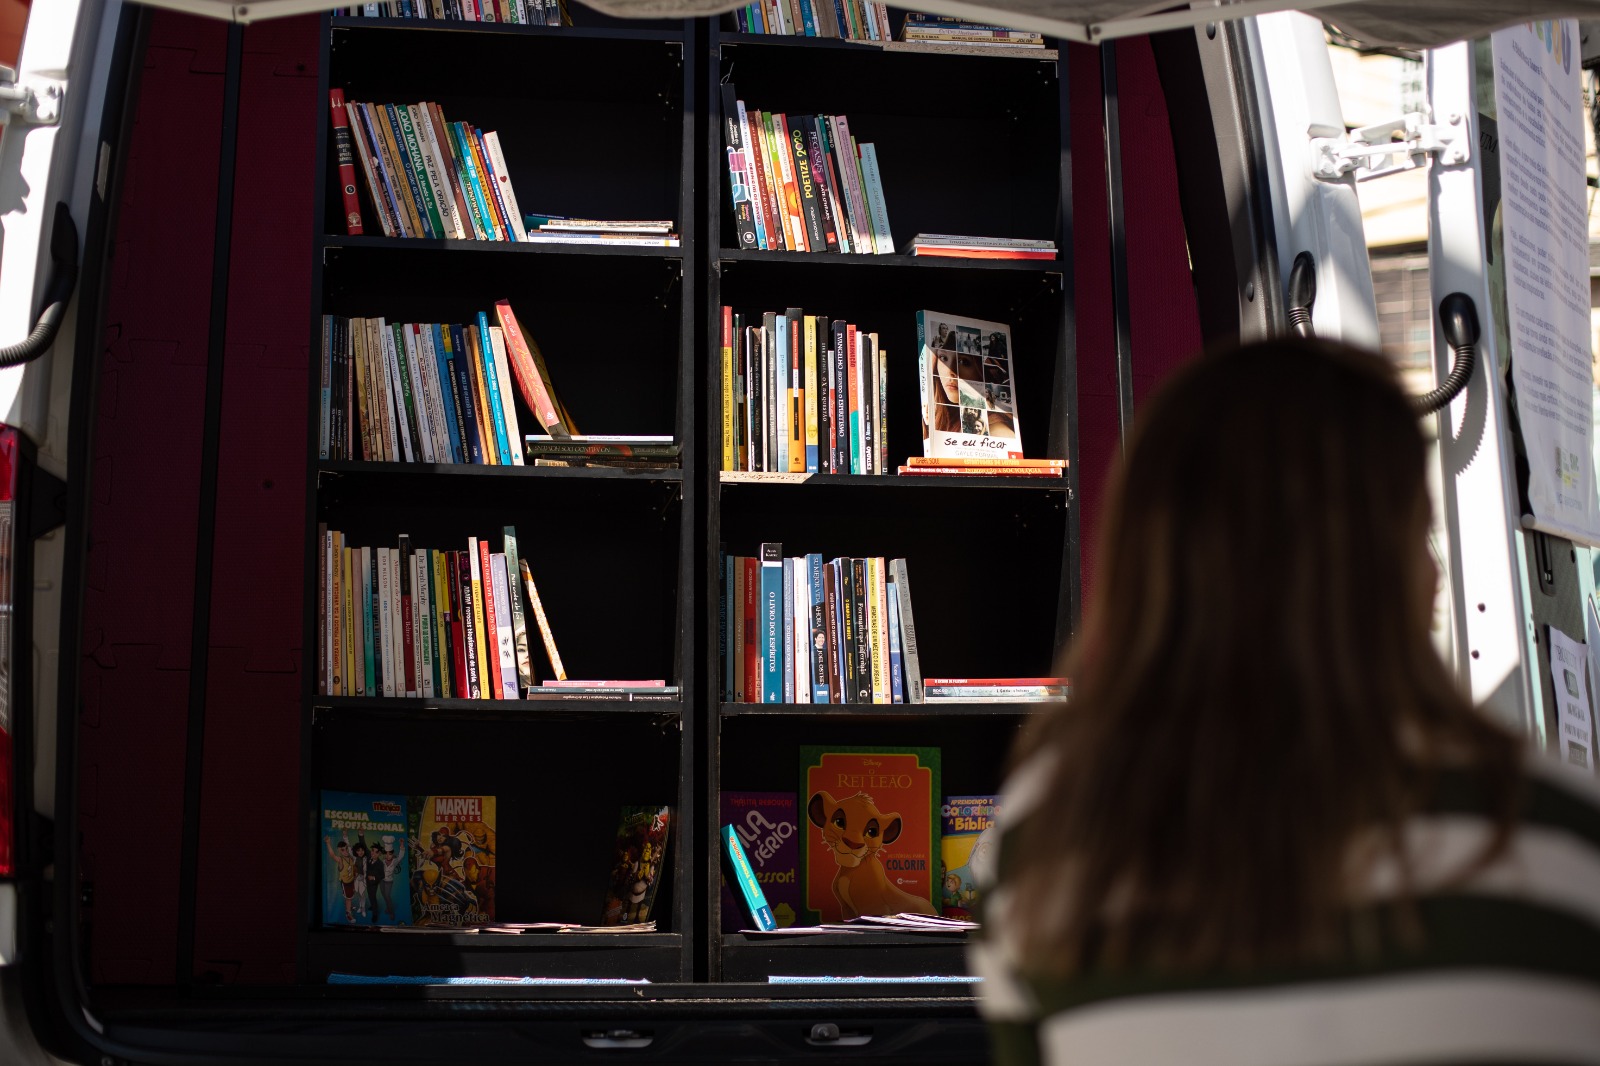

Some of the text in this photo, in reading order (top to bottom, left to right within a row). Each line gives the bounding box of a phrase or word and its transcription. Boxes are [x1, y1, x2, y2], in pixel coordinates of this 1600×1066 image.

[410, 106, 427, 143] JOÃO MOHANA
[399, 108, 425, 172] JOÃO MOHANA
[809, 130, 824, 174] PEGASUS
[792, 128, 814, 199] POETIZE 2020
[424, 155, 450, 218] PAZ PELA ORAÇÃO
[465, 181, 482, 219] EMMANUEL
[944, 437, 1007, 449] se eu ficar
[417, 566, 426, 583] Joseph
[813, 567, 821, 588] MEJOR
[419, 583, 427, 606] Murphy
[815, 605, 823, 628] AHORA
[857, 603, 866, 643] Formaturas
[769, 638, 777, 673] ESPÍRITOS
[863, 759, 882, 768] Disney
[837, 774, 865, 788] REI
[436, 798, 482, 816] MARVEL
[950, 798, 987, 806] APRENDENDO
[324, 809, 369, 821] ESCOLHA
[331, 820, 405, 832] PROFISSIONAL
[954, 818, 995, 832] Bíblia
[886, 859, 926, 871] COLORIR
[423, 903, 460, 913] Ameaça
[430, 911, 489, 924] Magnética
